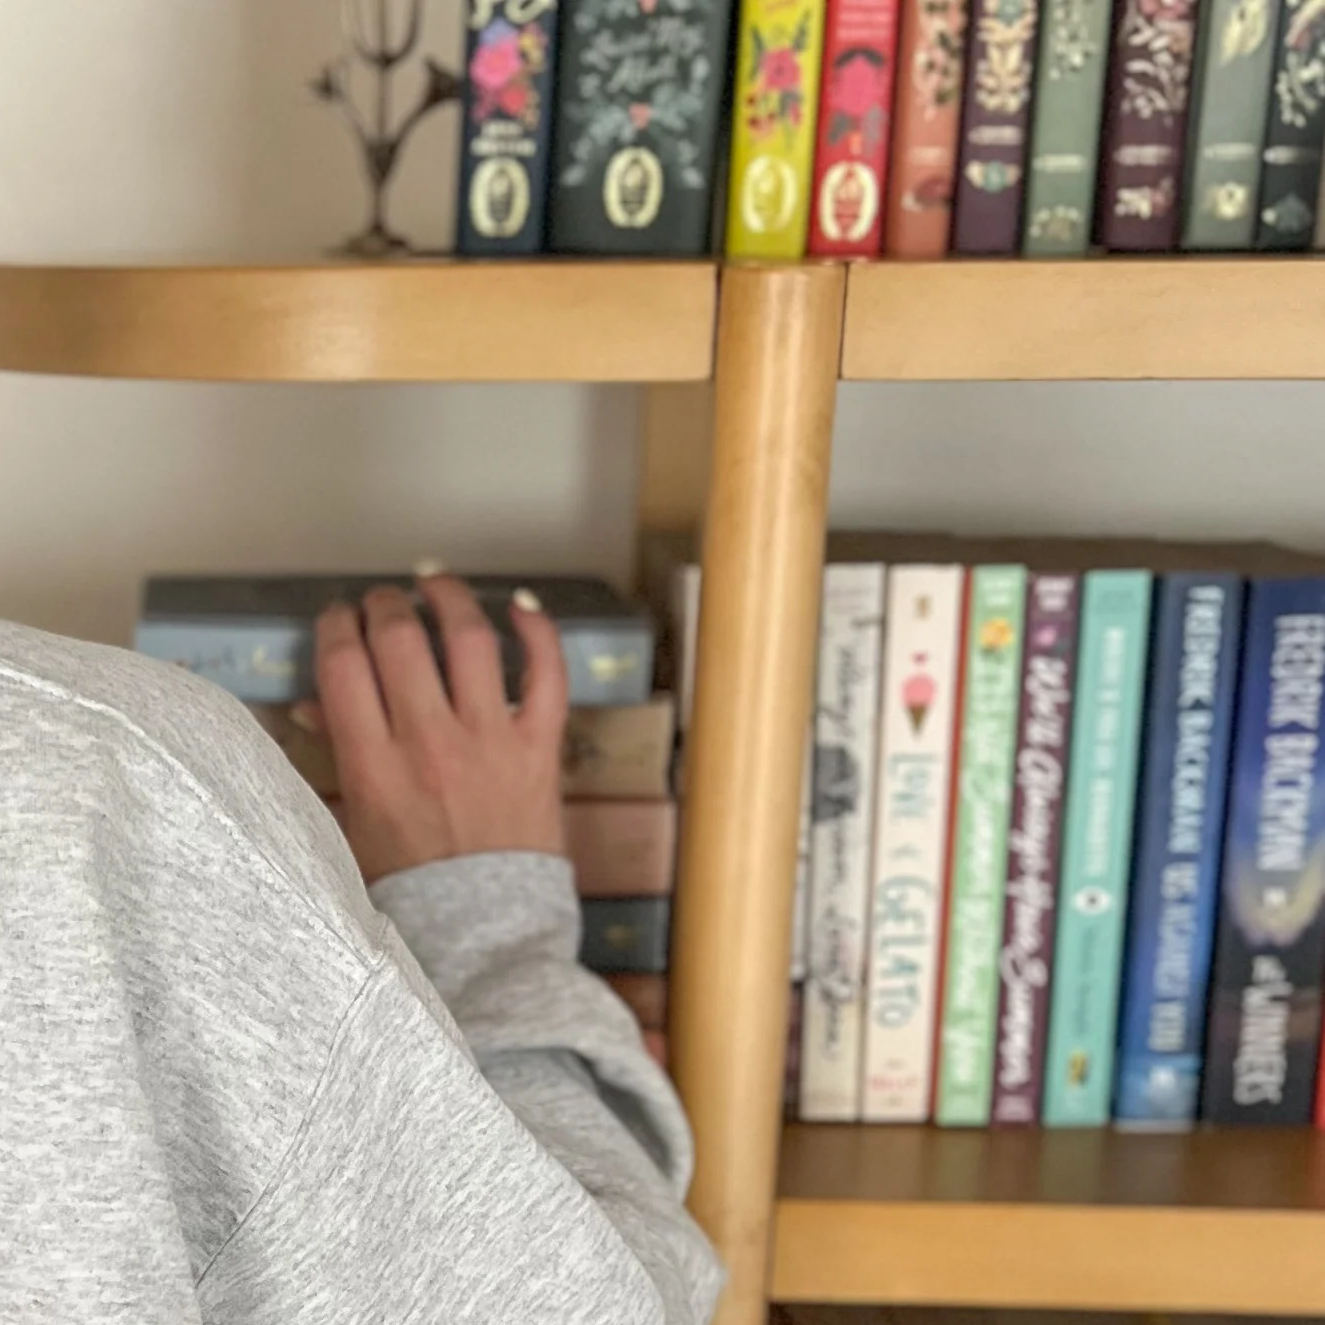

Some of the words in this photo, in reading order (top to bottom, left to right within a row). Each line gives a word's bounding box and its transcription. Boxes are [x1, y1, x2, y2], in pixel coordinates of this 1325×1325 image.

[1178, 584, 1224, 709] FREDRIK
[1268, 613, 1325, 730] FREDRIK
[1009, 748, 1064, 874] Always
[1168, 709, 1214, 853] BACKMAN
[1255, 732, 1320, 871] BACKMAN
[875, 874, 933, 1030] GELATO
[998, 943, 1049, 1090] Summer
[1232, 986, 1292, 1105] WINNERS
